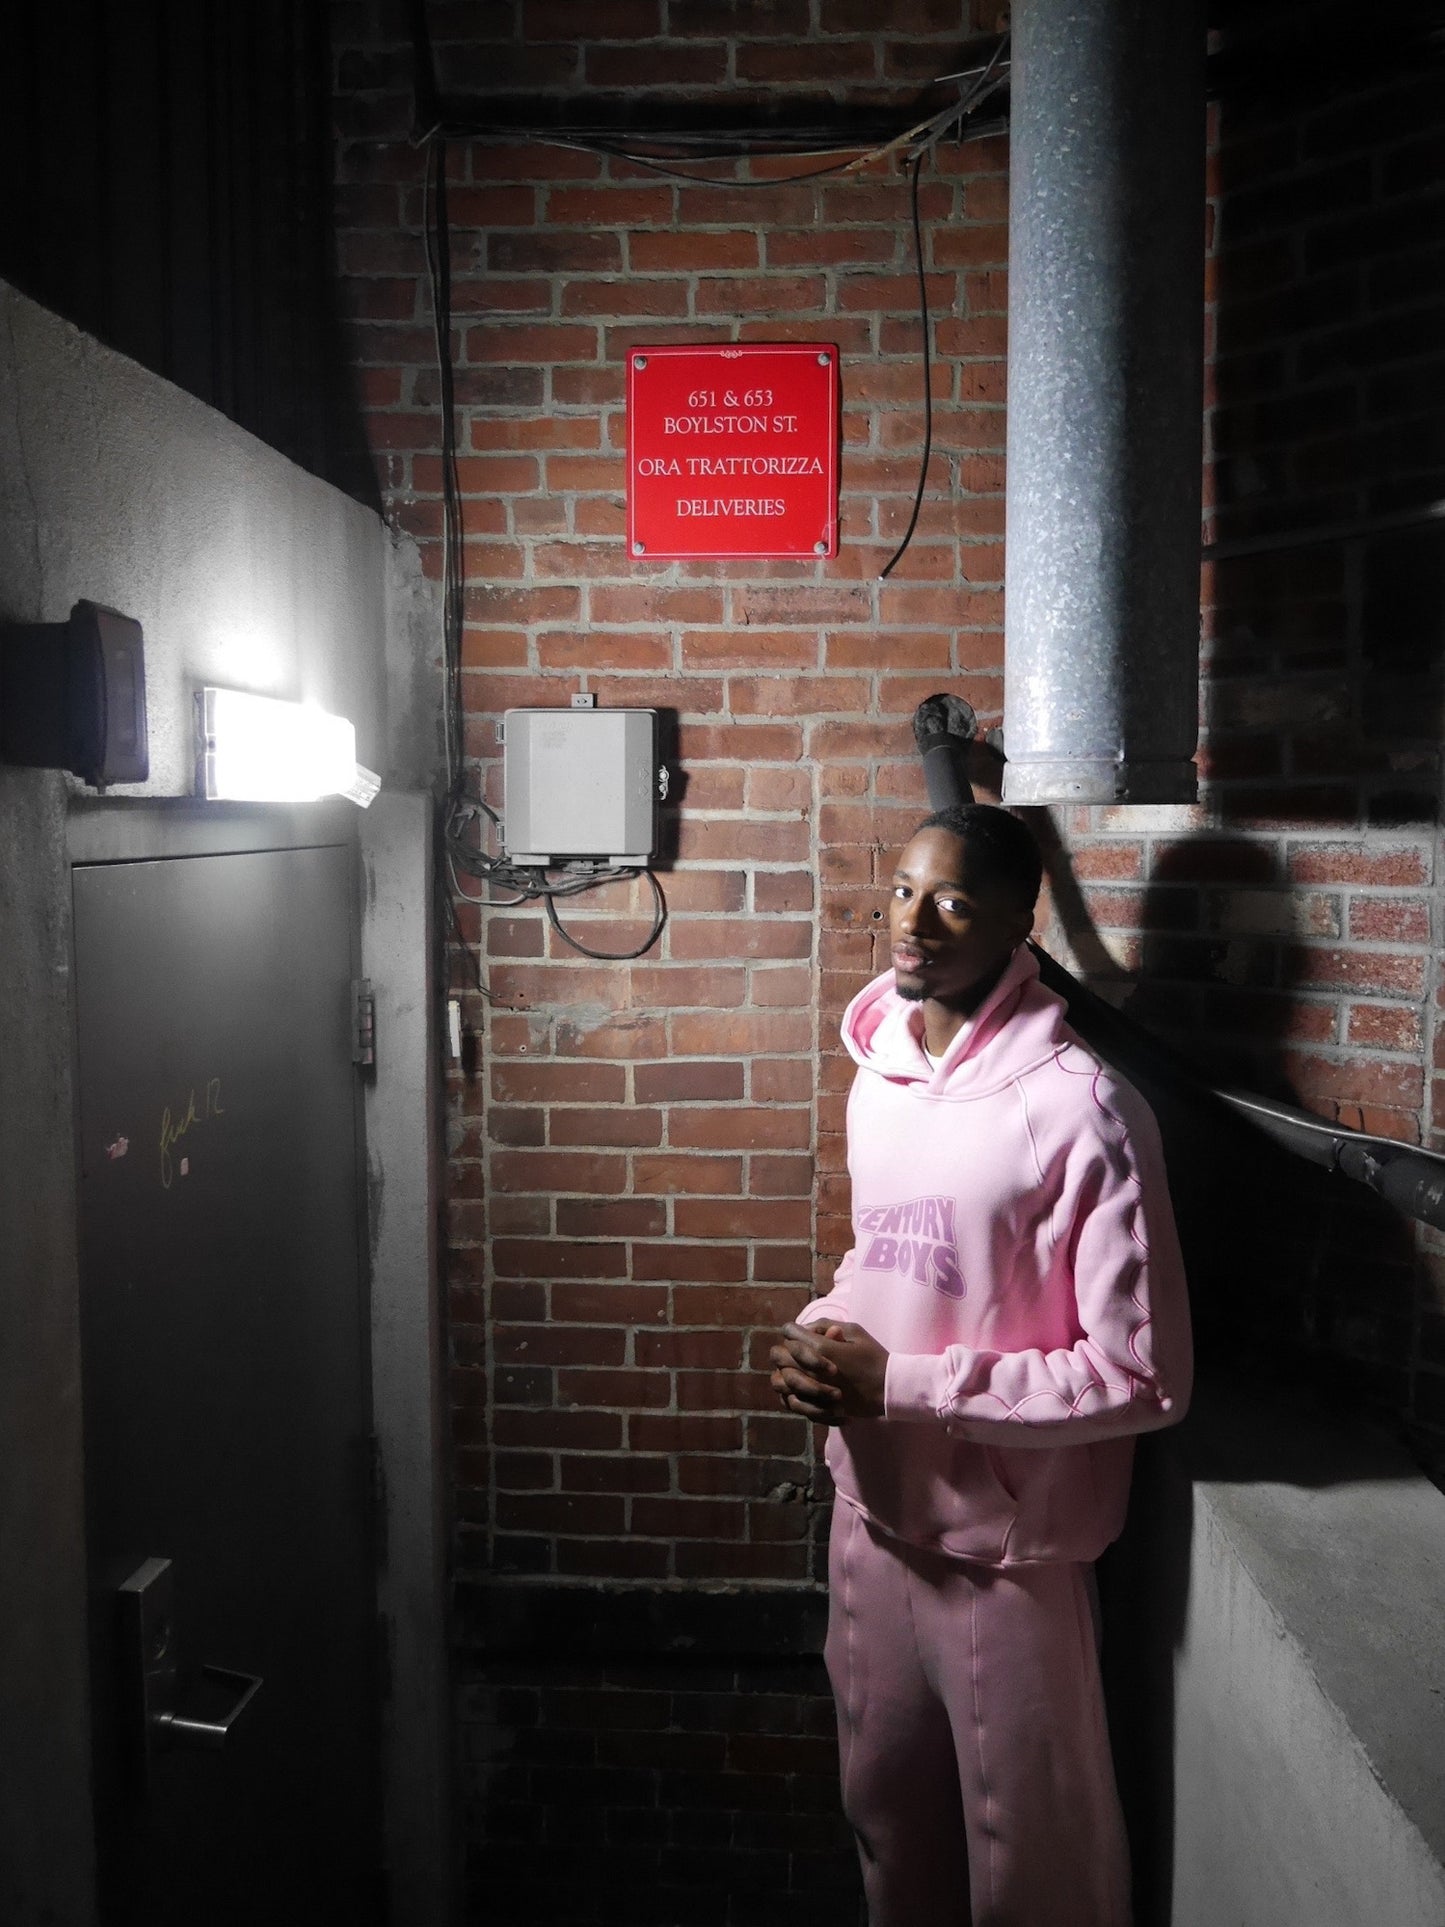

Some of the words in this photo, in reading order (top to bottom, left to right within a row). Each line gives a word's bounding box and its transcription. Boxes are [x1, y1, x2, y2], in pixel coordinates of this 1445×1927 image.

[688, 390, 716, 408] 651
[723, 390, 740, 407] &
[744, 390, 773, 407] 653
[664, 416, 768, 434] BOYLSTON
[772, 415, 798, 434] ST.
[638, 458, 682, 476] ORA
[685, 457, 824, 475] TRATTORIZZA
[676, 498, 786, 516] DELIVERIES
[861, 1236, 967, 1299] BOYS
